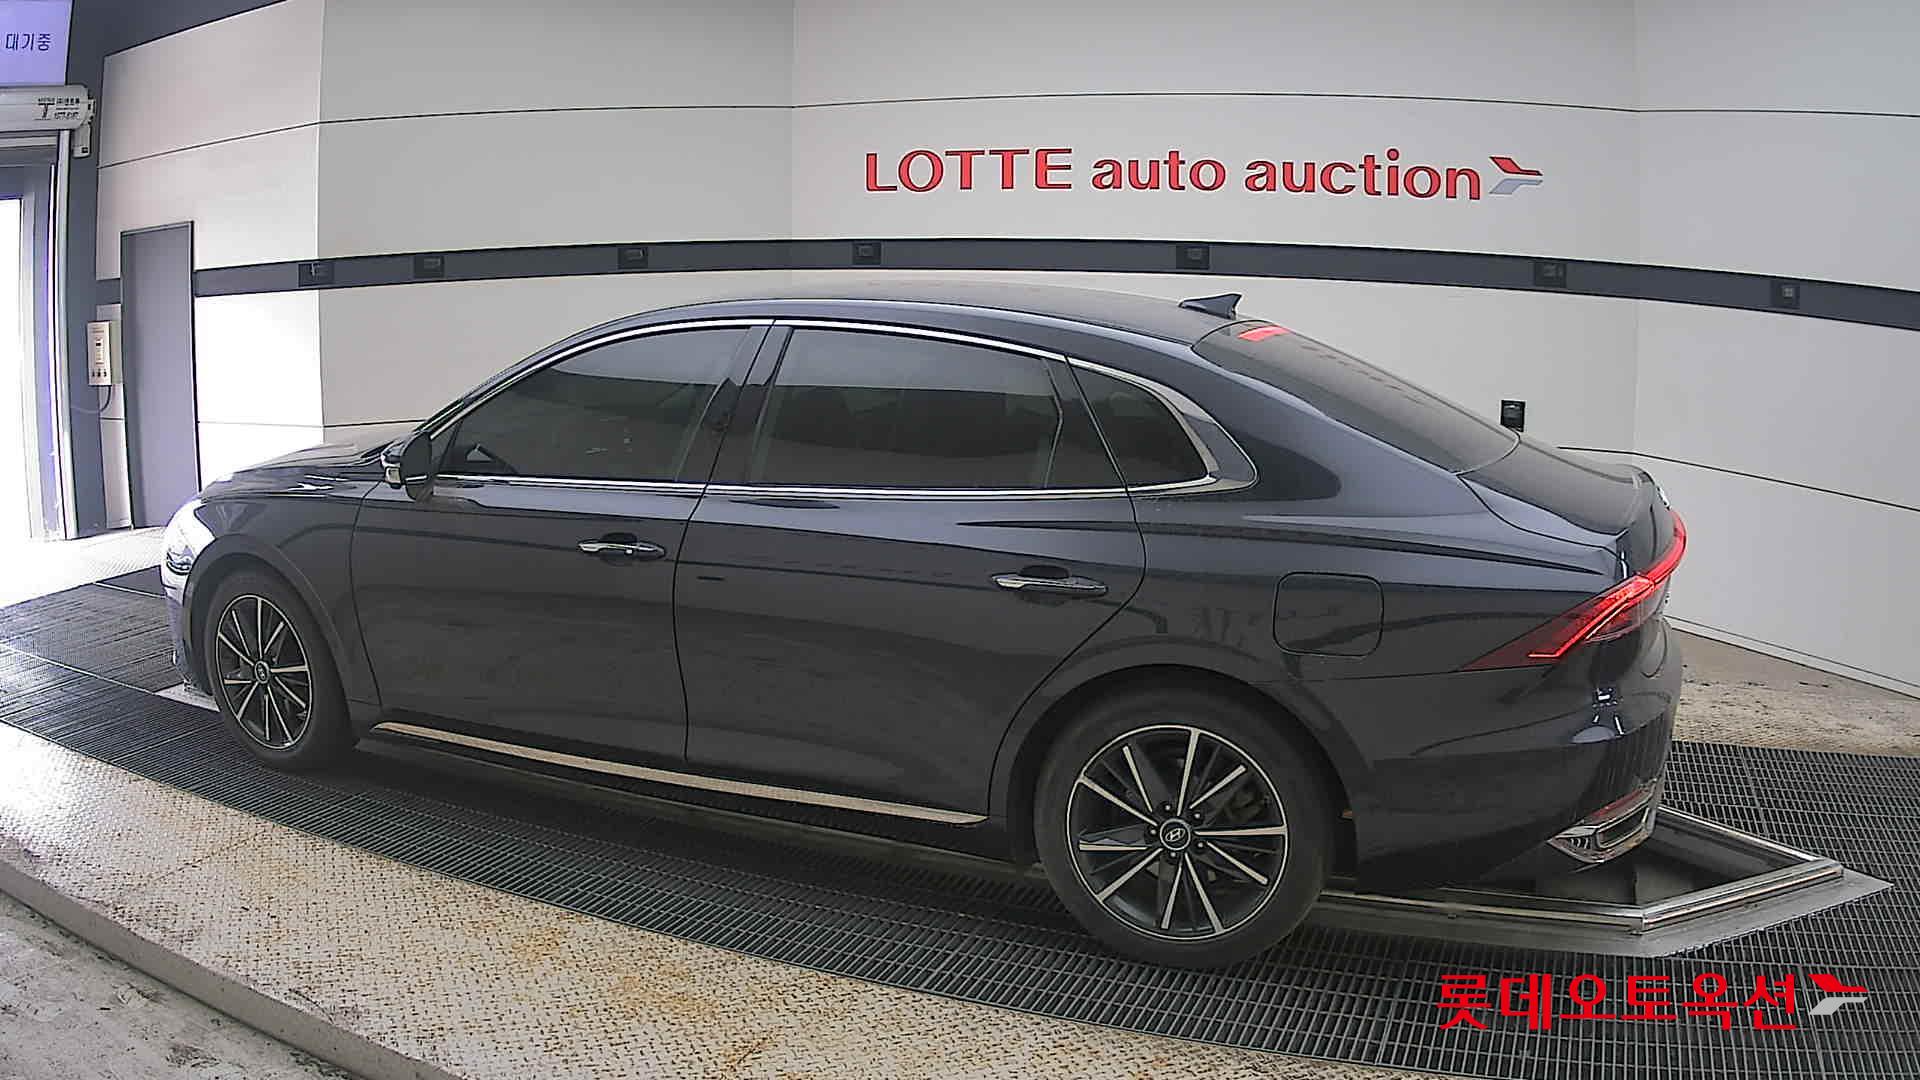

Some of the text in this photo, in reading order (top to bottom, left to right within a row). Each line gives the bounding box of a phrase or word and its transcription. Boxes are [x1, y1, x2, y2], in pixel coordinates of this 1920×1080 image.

[5, 33, 51, 51] 대기중
[865, 149, 1481, 200] LOTTE auto auction
